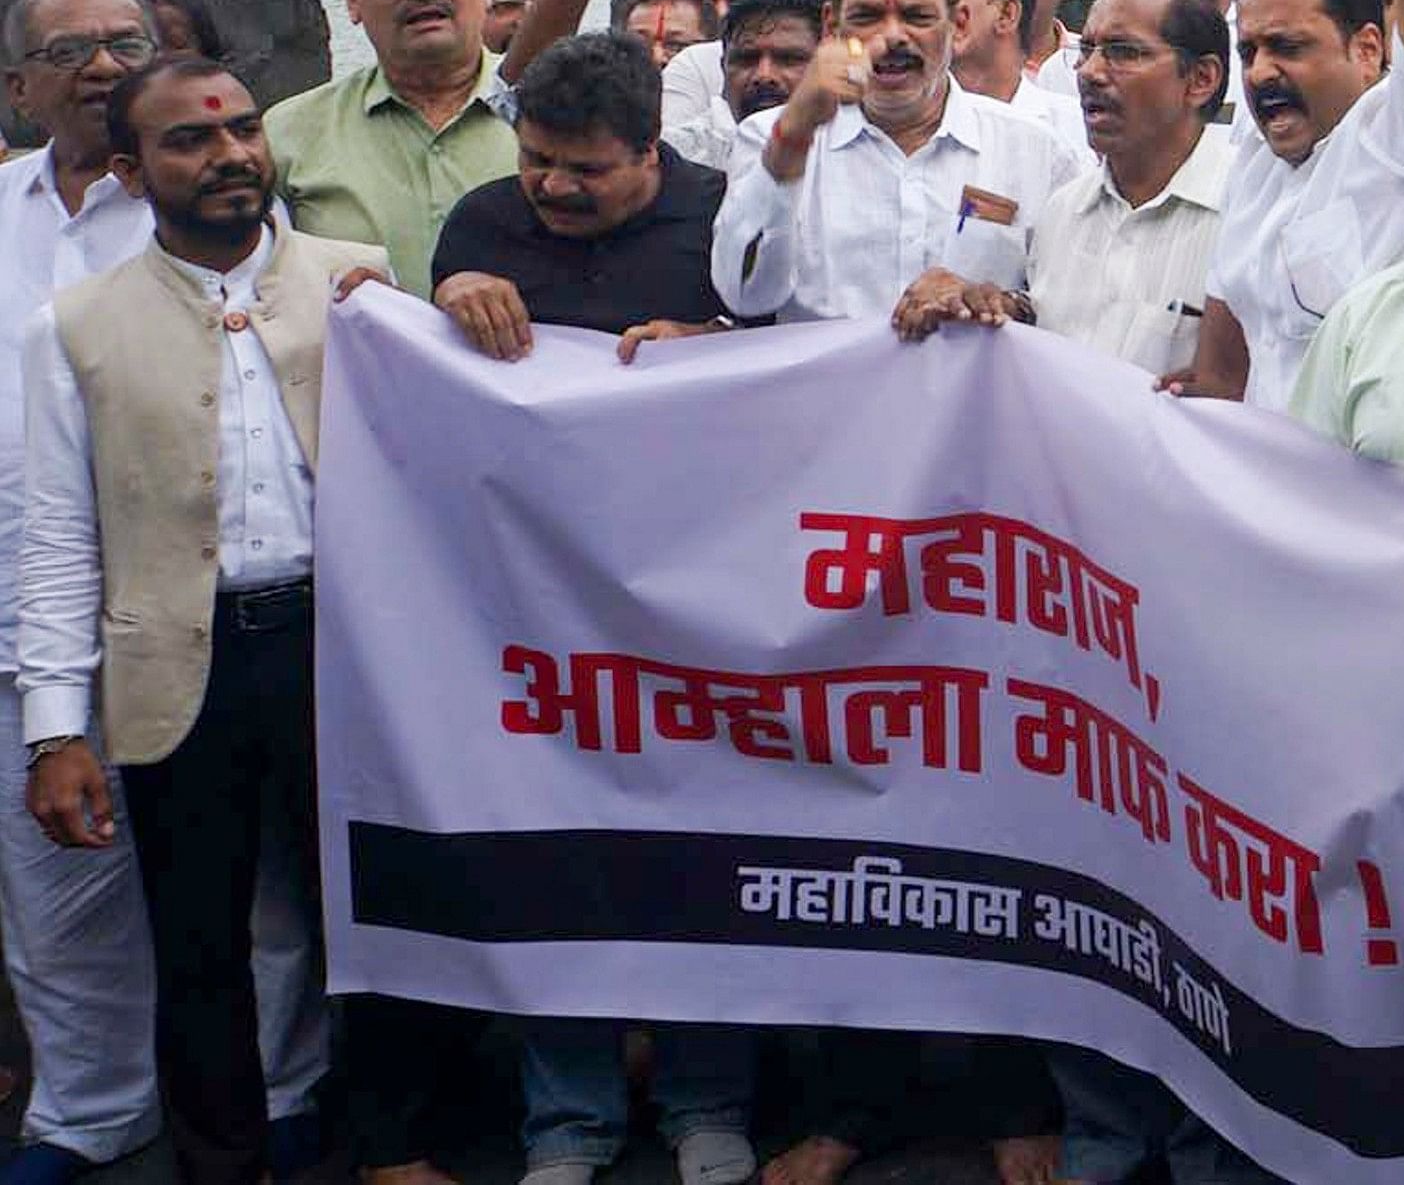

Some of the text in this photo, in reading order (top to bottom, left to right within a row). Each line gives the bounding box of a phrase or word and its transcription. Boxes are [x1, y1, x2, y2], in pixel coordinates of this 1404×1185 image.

[800, 512, 1162, 724] महाराज,
[501, 644, 1399, 966] आम्हाला माफ करा !
[736, 856, 1022, 940] महाविकास
[1034, 890, 1170, 1006] आघाडी,
